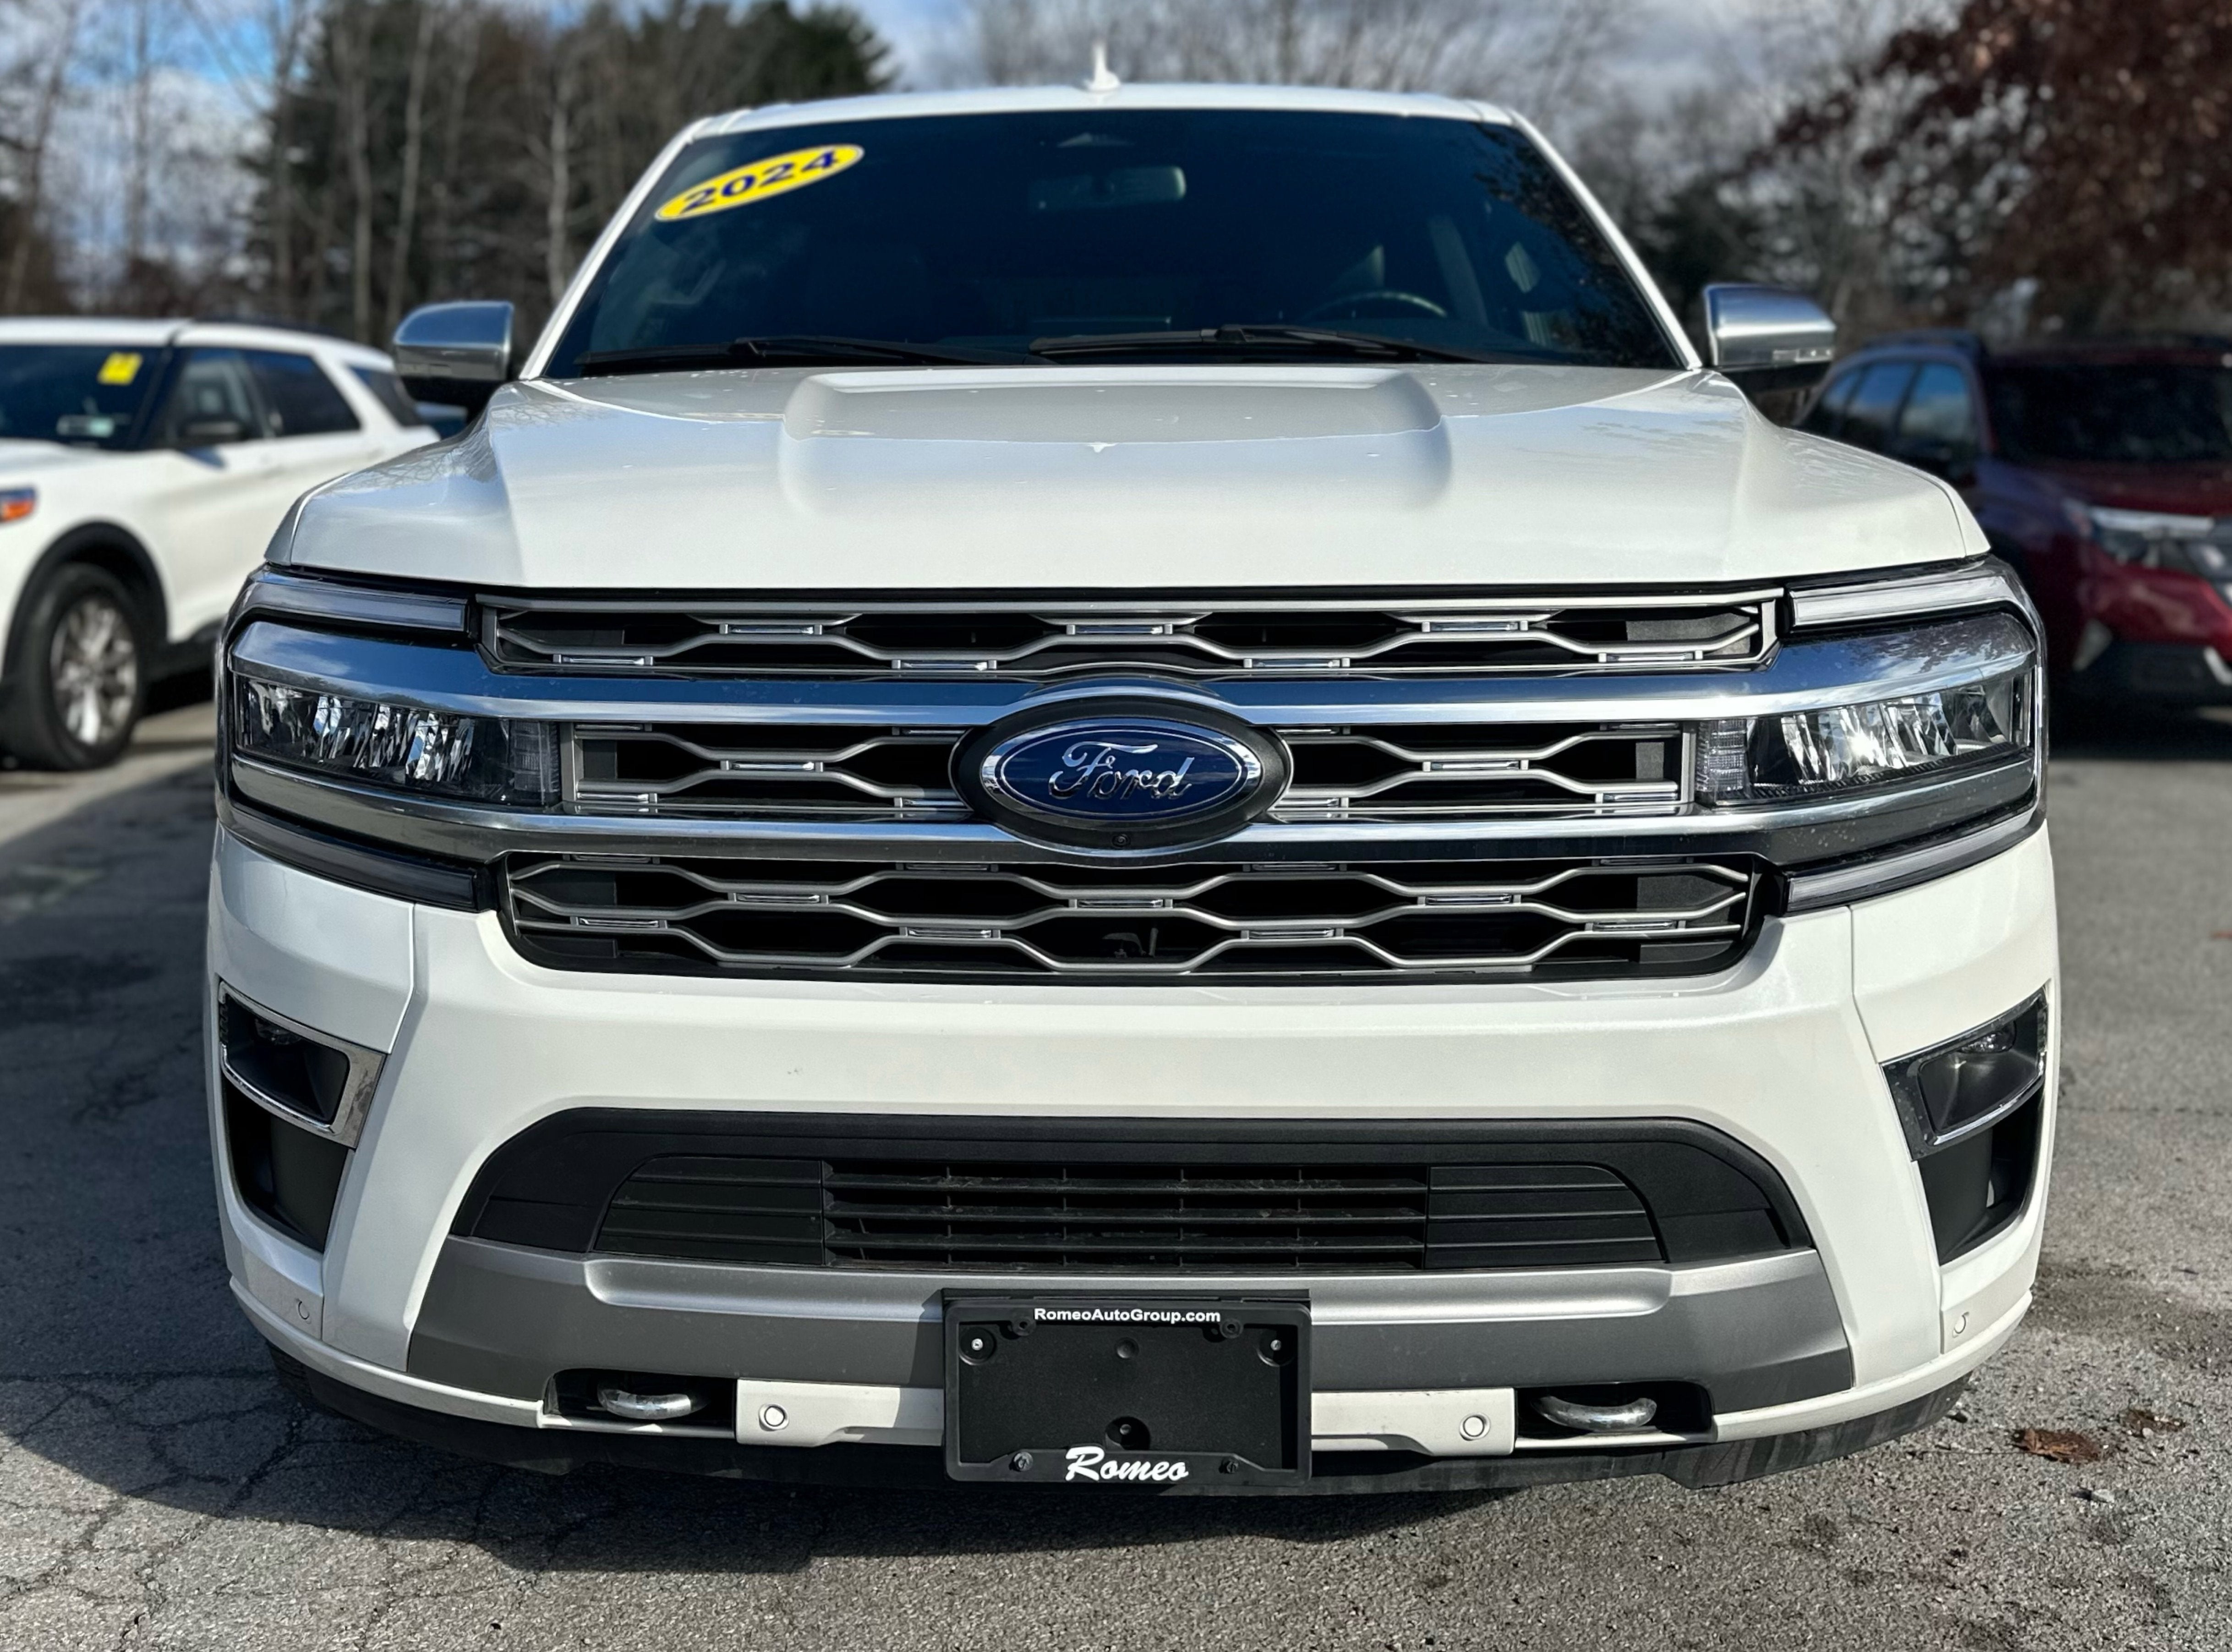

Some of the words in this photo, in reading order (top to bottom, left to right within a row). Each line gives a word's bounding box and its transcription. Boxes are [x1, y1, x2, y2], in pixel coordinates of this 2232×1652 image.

[679, 150, 839, 214] 2024
[1048, 741, 1195, 800] Ford
[1034, 1308, 1220, 1324] RomeoAutoGroup.com
[1065, 1446, 1189, 1481] Romeo
